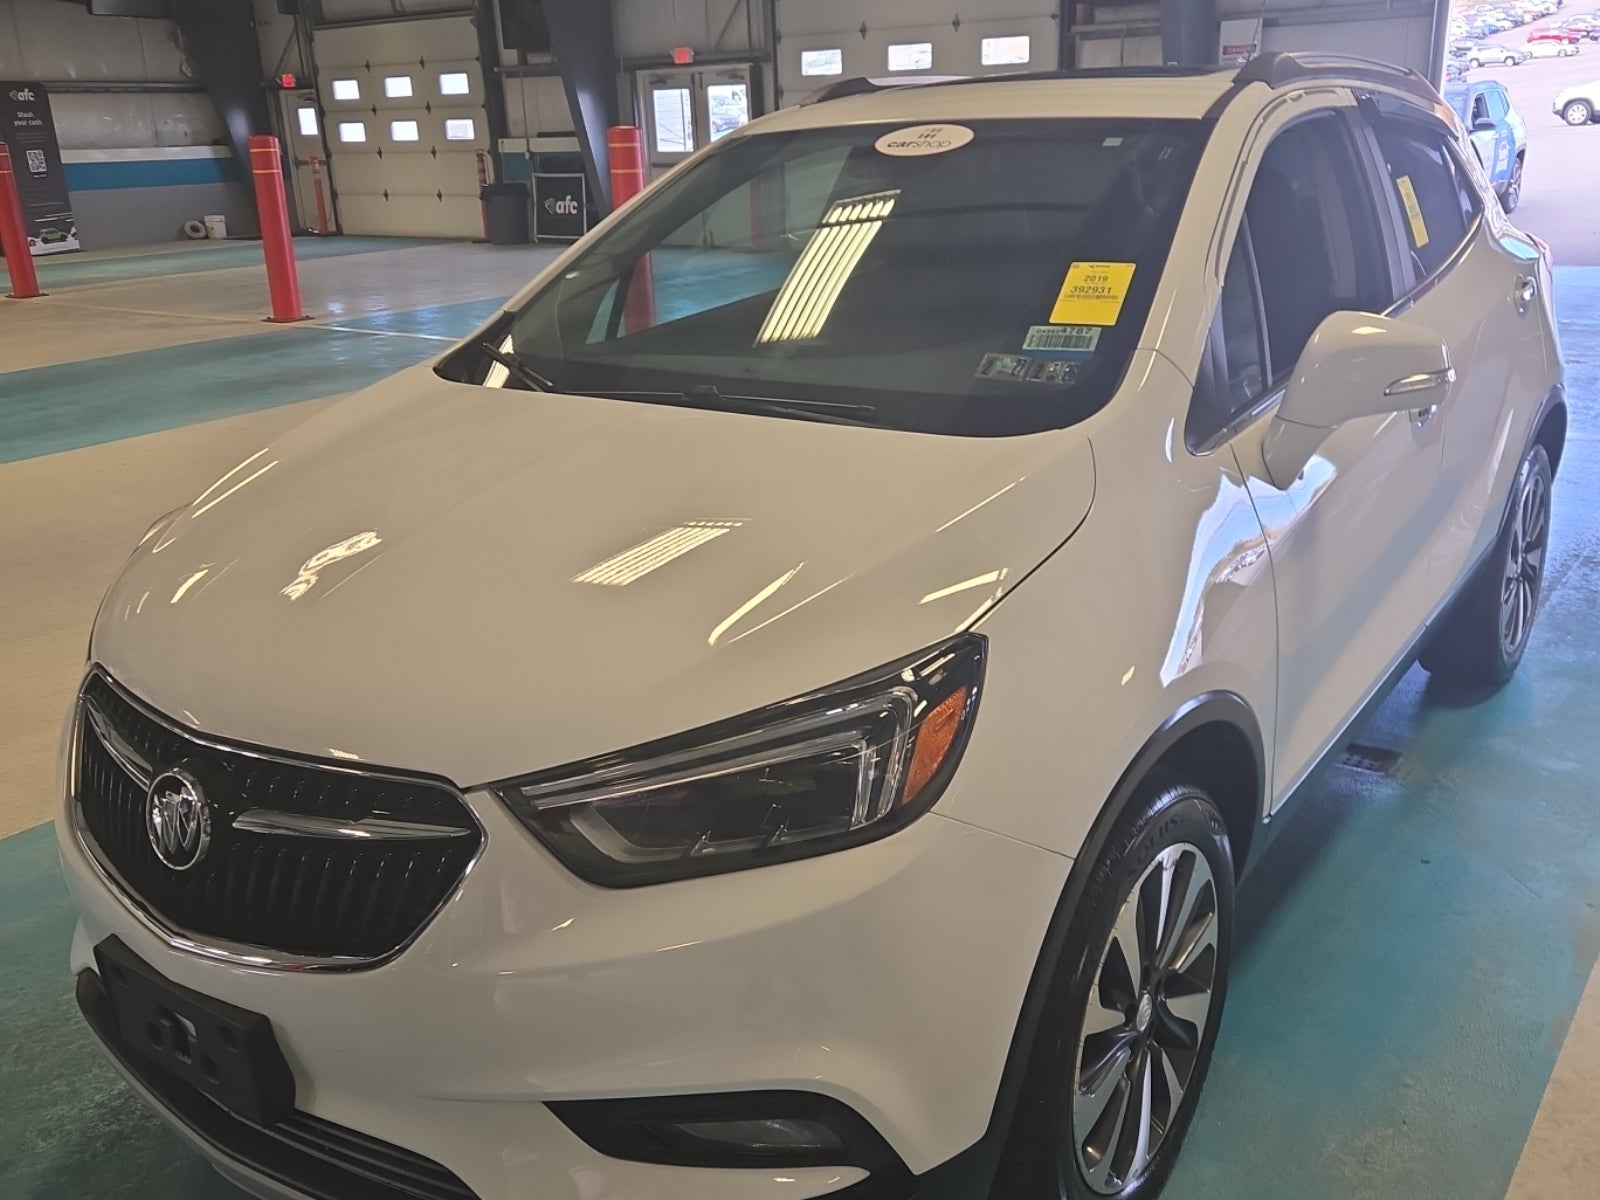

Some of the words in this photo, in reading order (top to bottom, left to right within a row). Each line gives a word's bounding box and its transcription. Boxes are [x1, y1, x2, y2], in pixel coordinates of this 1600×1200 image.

[17, 88, 36, 102] afc
[555, 194, 578, 214] afc
[1083, 275, 1109, 283] 2019
[1070, 285, 1112, 295] 392931
